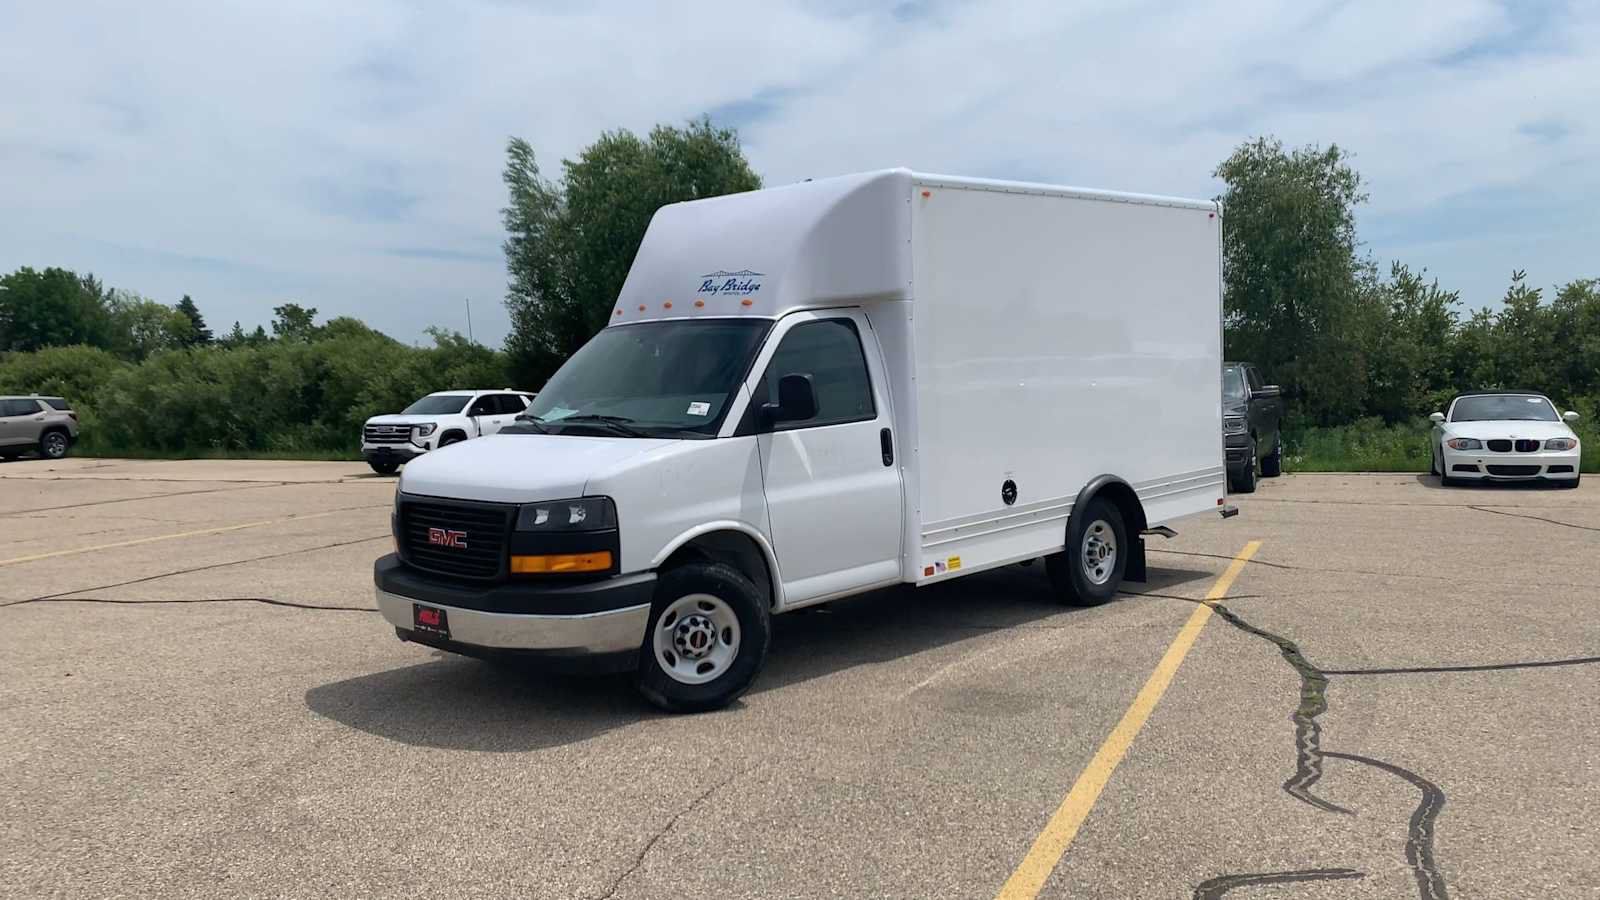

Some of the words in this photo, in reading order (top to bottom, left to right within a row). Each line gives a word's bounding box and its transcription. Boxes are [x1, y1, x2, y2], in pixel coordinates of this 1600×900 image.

[697, 279, 720, 295] Bay
[720, 278, 760, 294] Bridge
[429, 527, 467, 549] GMC
